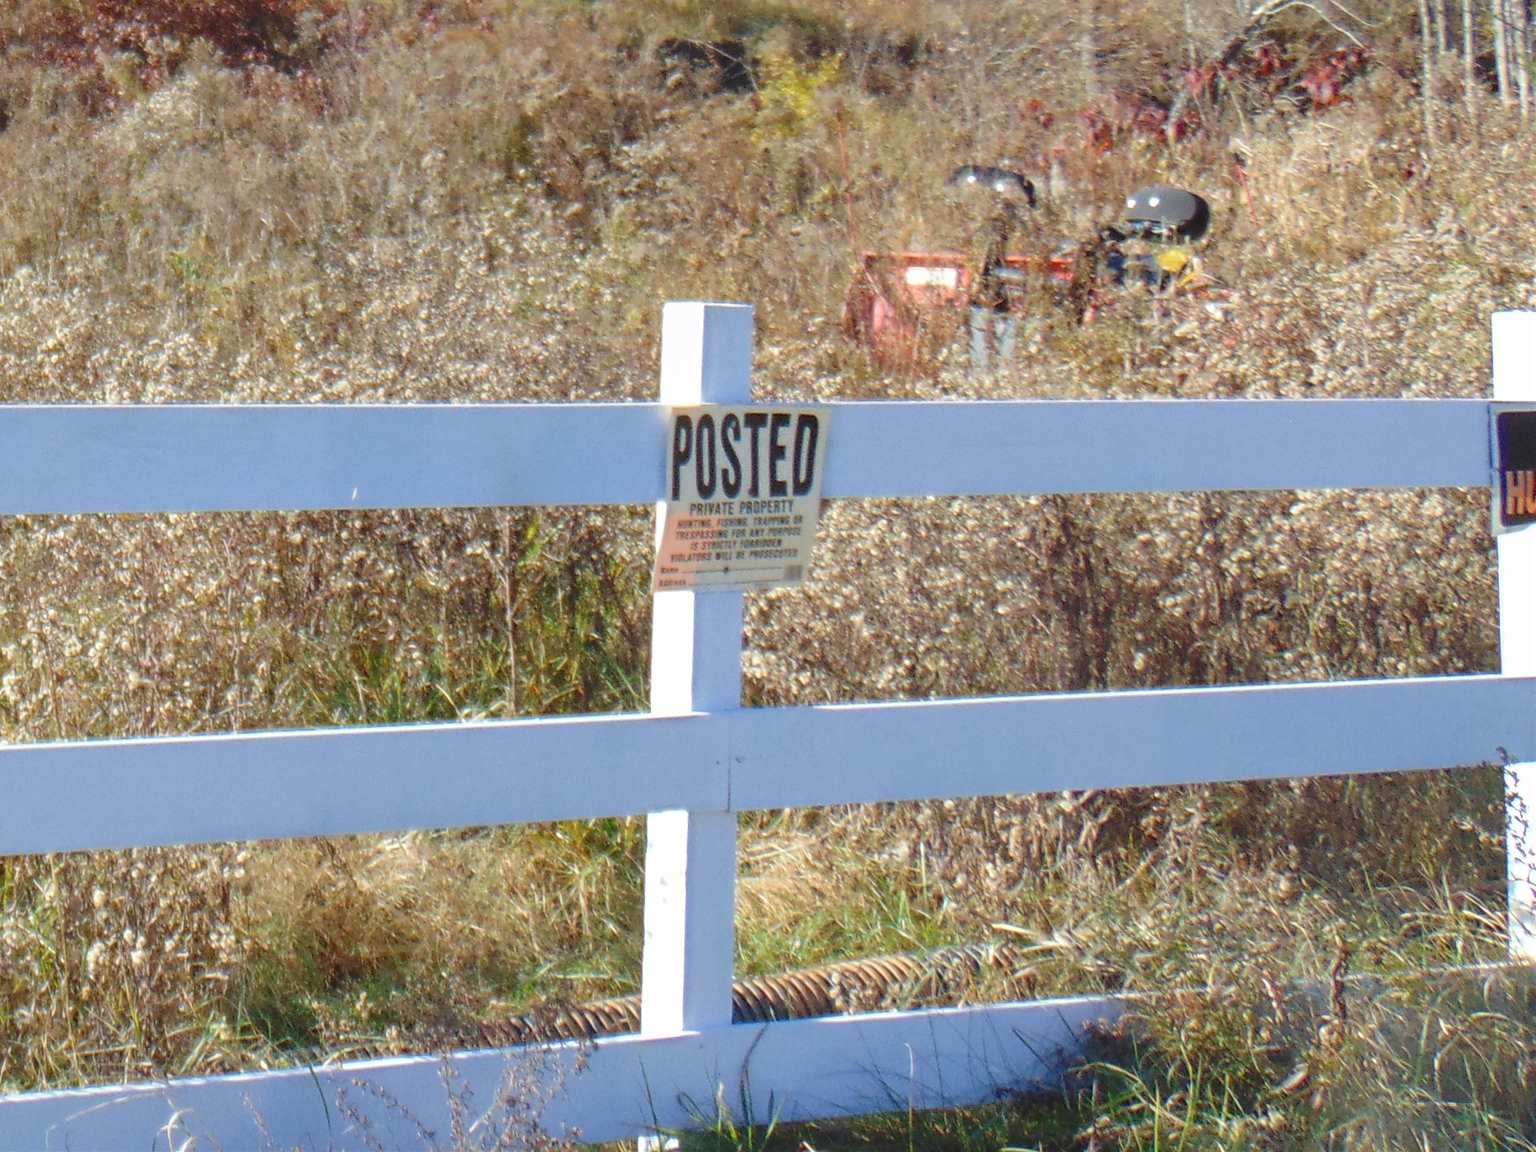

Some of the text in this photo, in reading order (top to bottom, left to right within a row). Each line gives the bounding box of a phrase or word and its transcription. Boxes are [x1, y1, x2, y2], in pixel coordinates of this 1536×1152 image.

[671, 412, 820, 501] POSTED
[689, 499, 794, 516] PRIVATE PROPERTY
[675, 529, 728, 540] TRESPASSING
[730, 528, 747, 539] FOR
[750, 527, 766, 538] ANY
[690, 540, 698, 551] IS
[700, 540, 737, 551] STRICTLY
